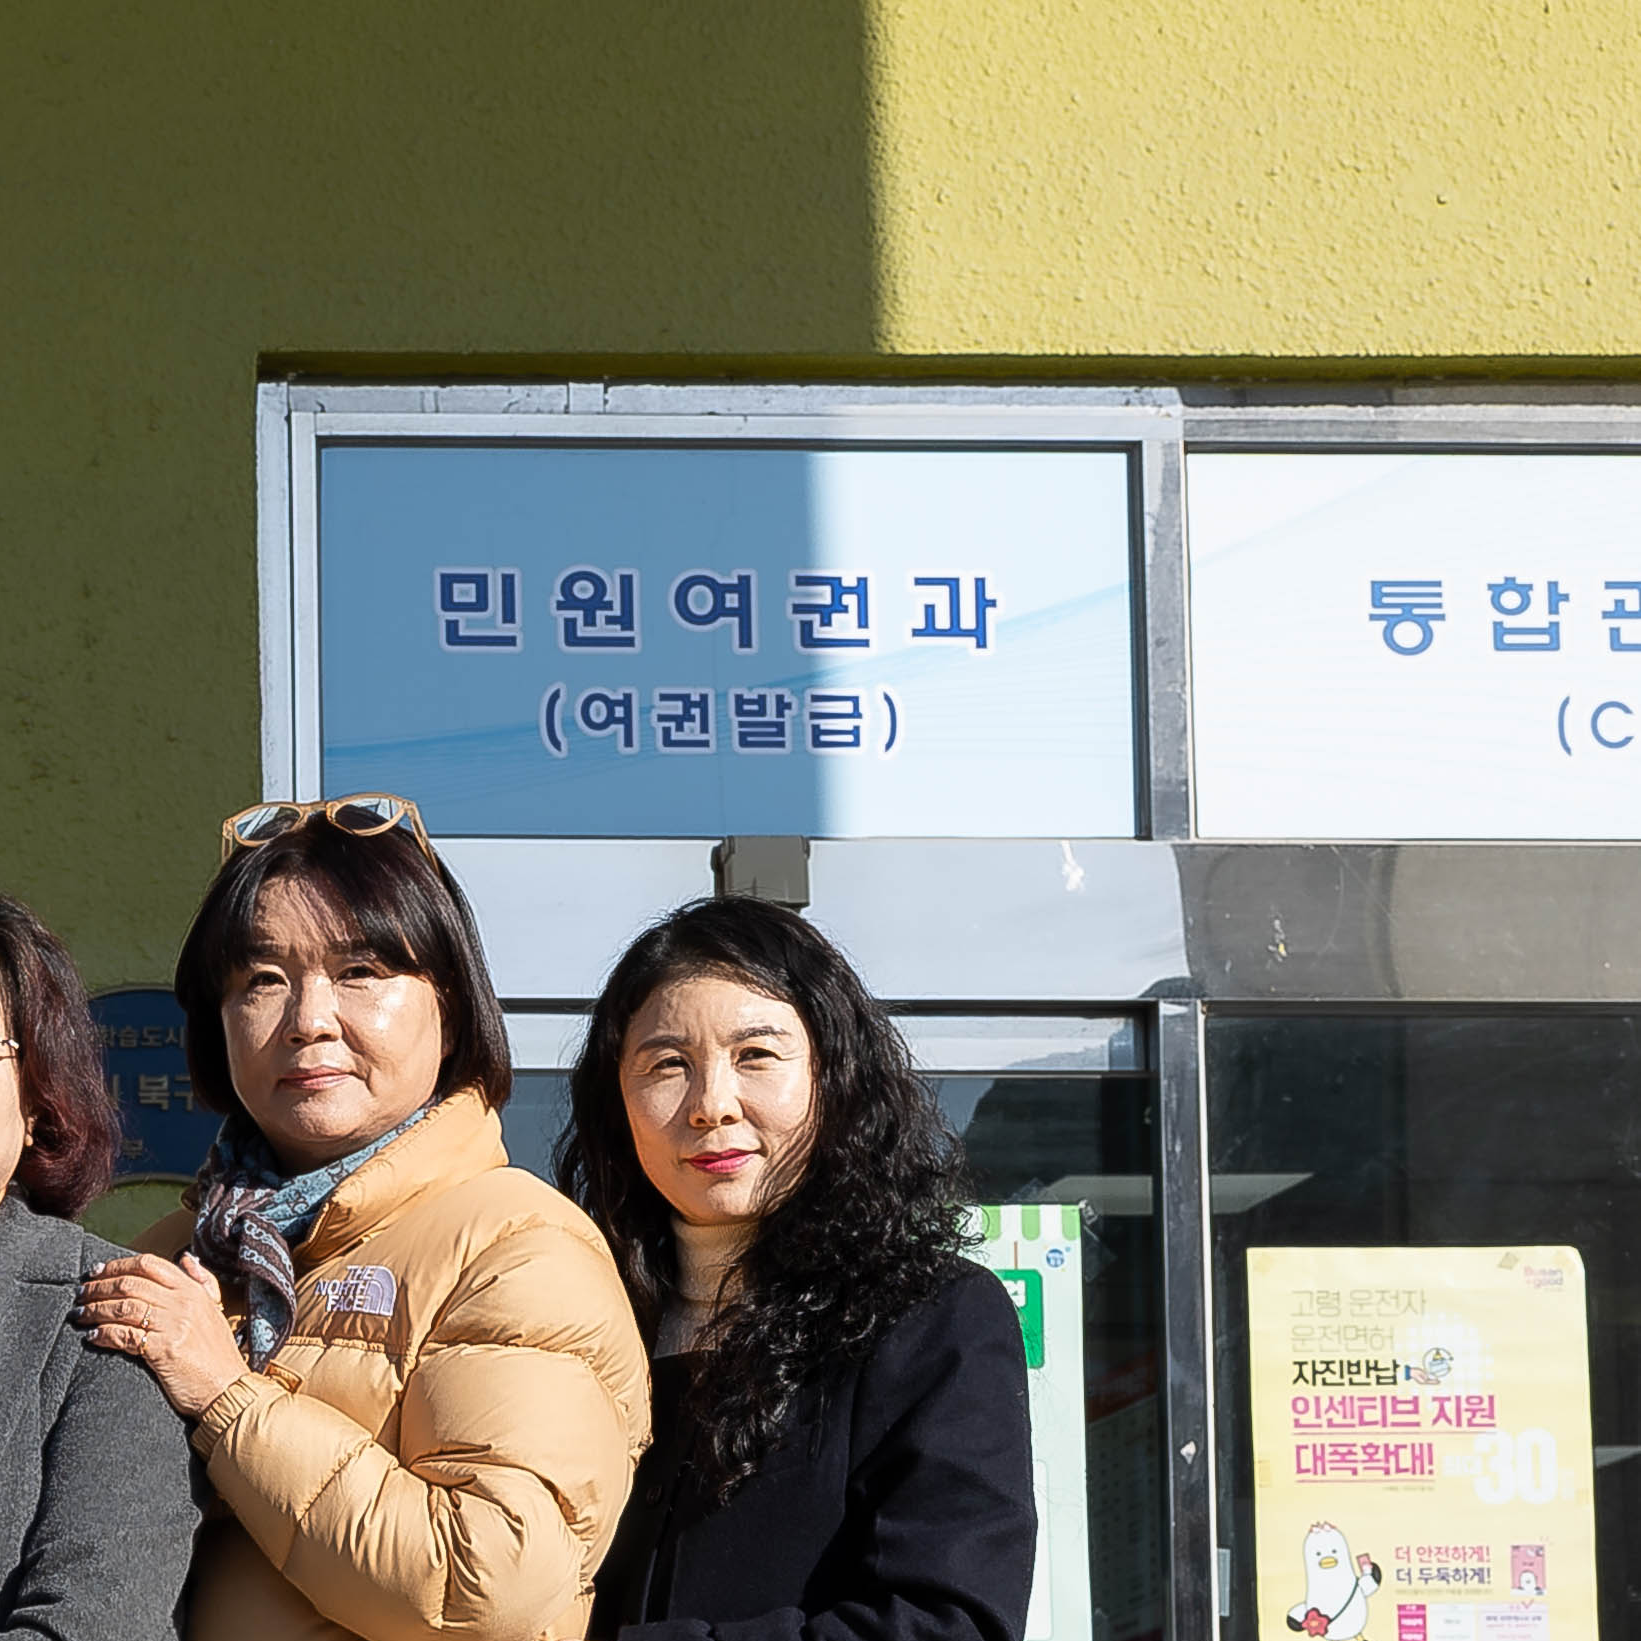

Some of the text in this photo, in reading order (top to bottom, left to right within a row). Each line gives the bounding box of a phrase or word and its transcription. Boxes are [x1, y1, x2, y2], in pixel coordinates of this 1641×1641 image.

[438, 568, 999, 652] 민원여권과
[541, 688, 903, 755] (여권발급)
[347, 1265, 375, 1280] THE
[315, 1278, 368, 1295] NORTH
[326, 1295, 366, 1312] FACE
[1290, 1288, 1426, 1317] 고령 운전자
[1290, 1324, 1395, 1352] 운전면허
[1292, 1360, 1401, 1386] 자진반납
[1292, 1395, 1497, 1428] 인센티브 지원
[1296, 1443, 1434, 1476] 대폭확대!
[1395, 1545, 1491, 1564] 더 안전하게!
[1396, 1567, 1492, 1586] 더 두둑하게!
